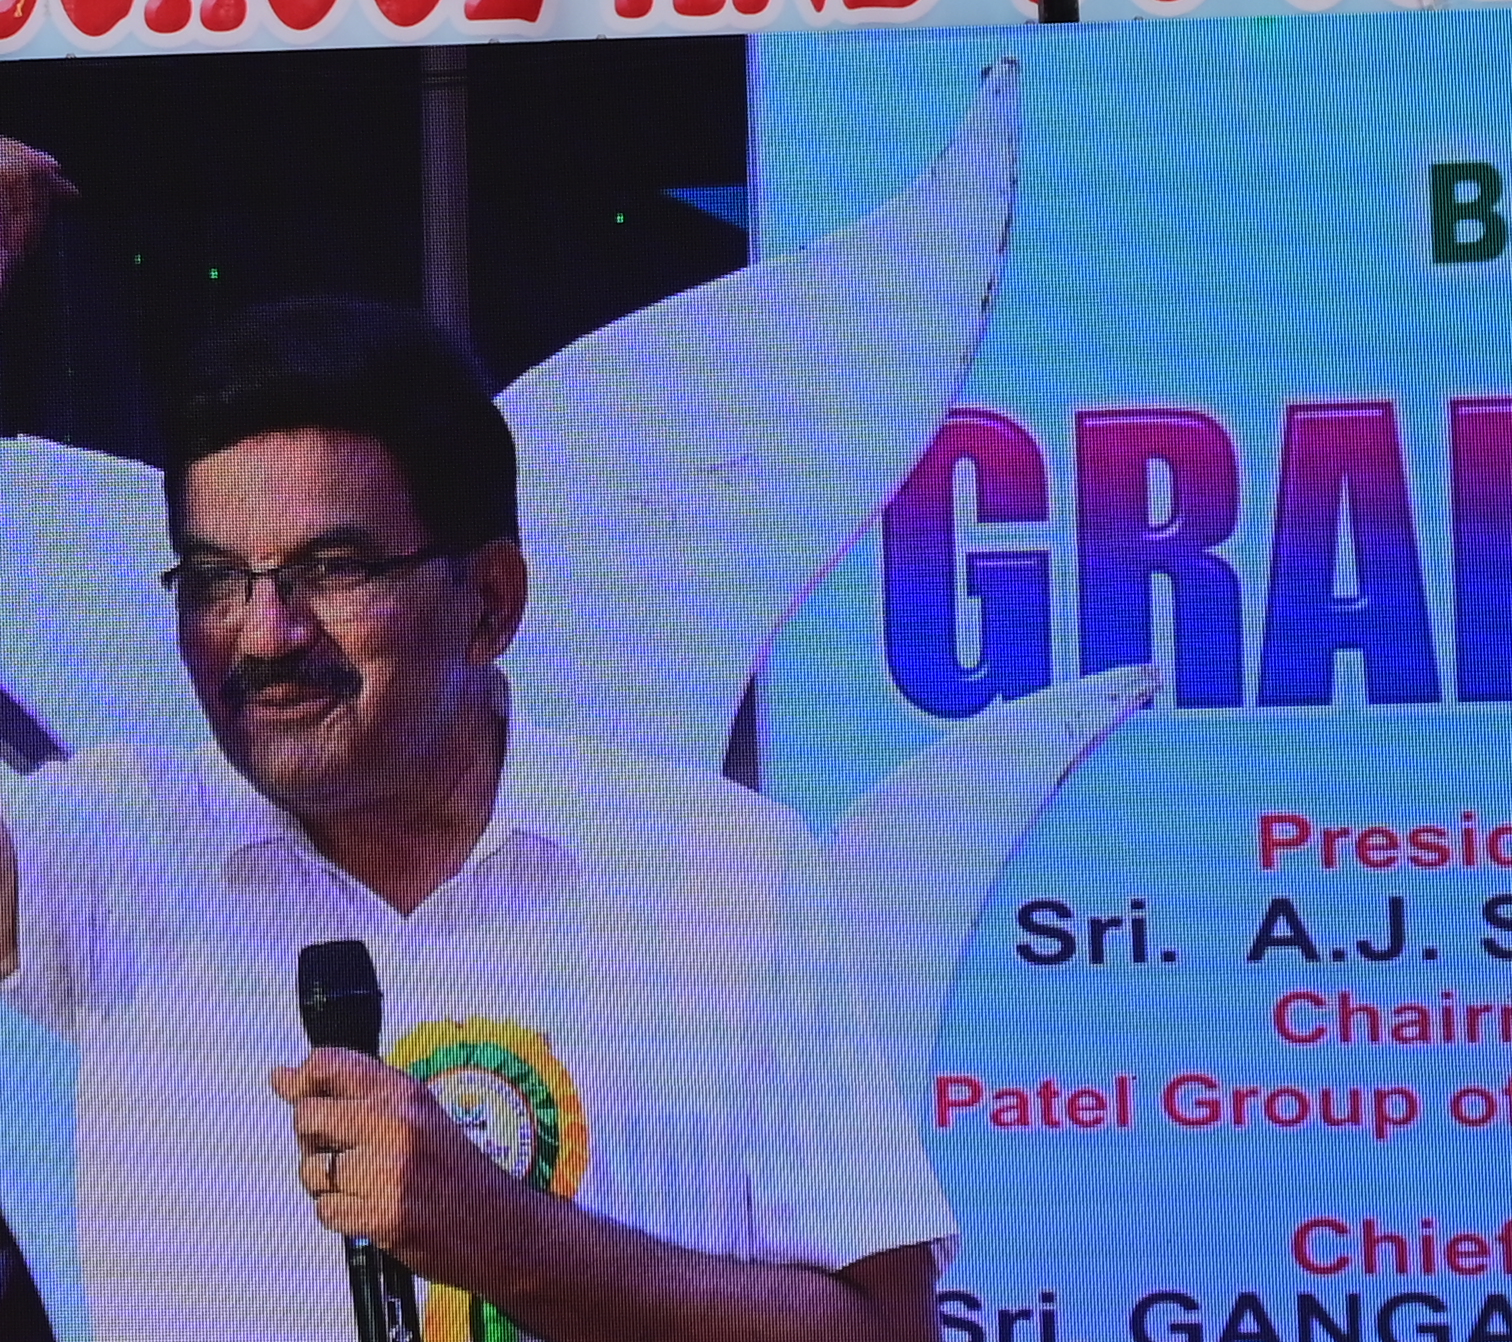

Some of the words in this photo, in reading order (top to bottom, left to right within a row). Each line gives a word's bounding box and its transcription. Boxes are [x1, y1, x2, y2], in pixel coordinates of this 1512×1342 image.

[1428, 161, 1509, 265] B
[1015, 898, 1179, 966] Sri.
[1247, 895, 1438, 963] A.J.
[934, 1074, 1133, 1129] Patel
[1162, 1073, 1420, 1141] Group
[1449, 1074, 1512, 1128] o
